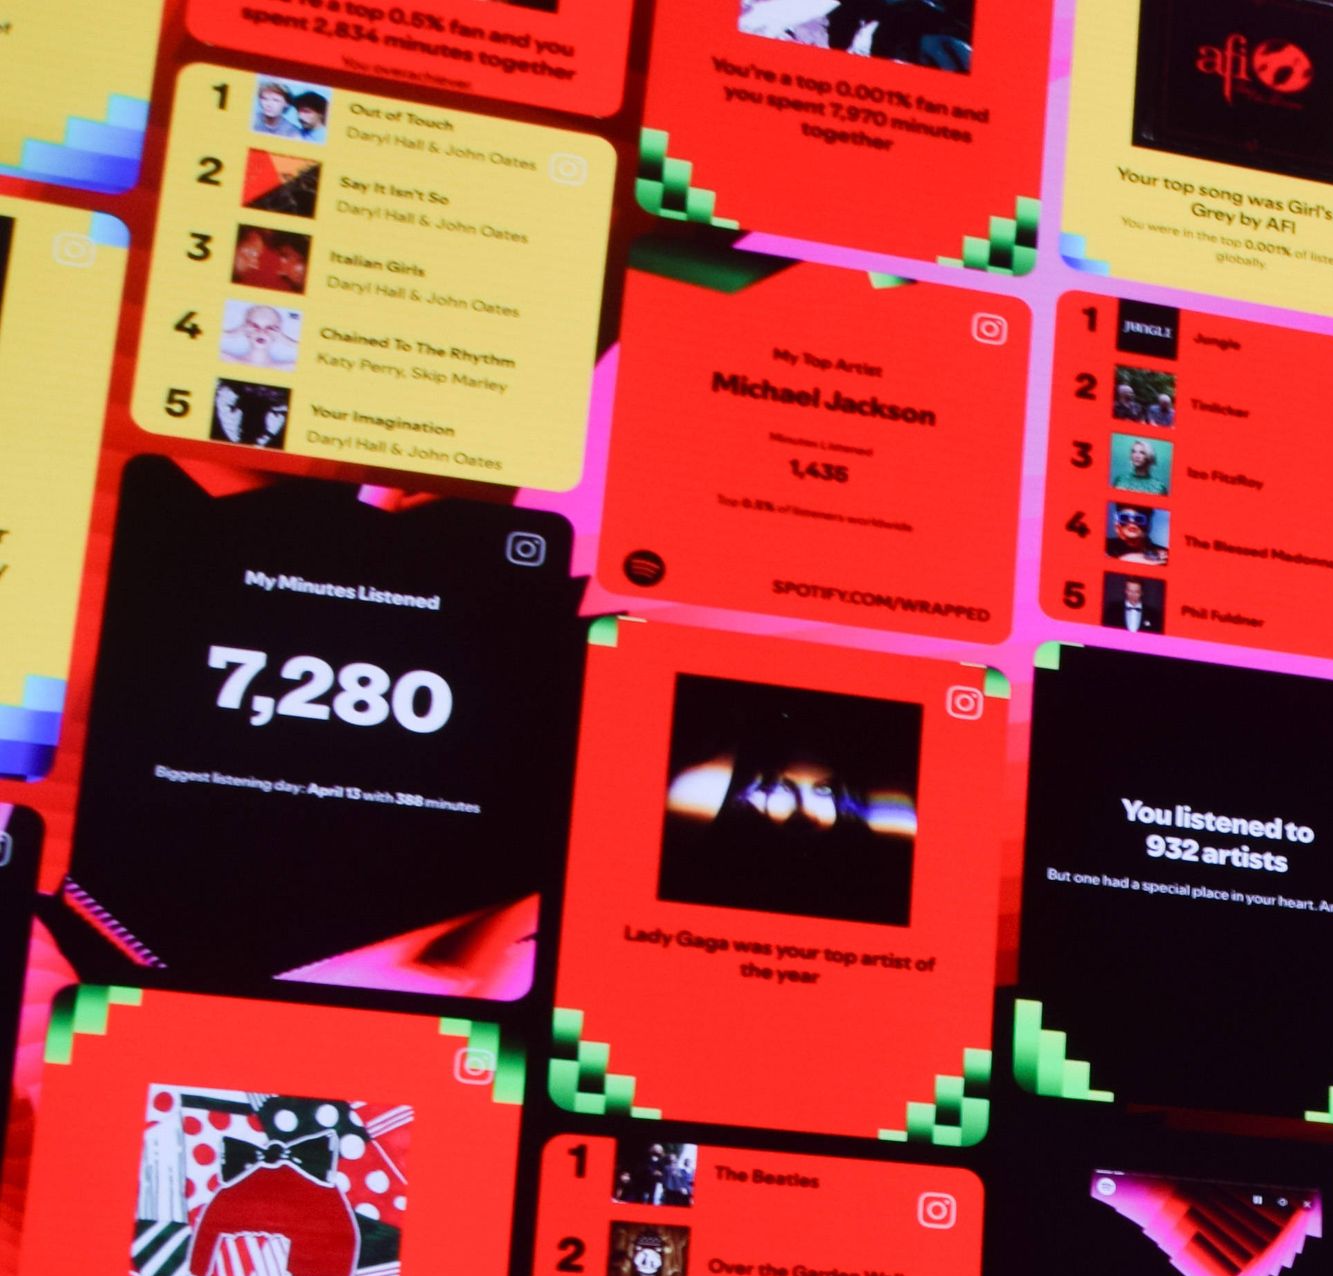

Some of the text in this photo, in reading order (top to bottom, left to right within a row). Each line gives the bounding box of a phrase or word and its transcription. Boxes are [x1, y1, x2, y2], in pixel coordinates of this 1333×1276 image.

[212, 82, 229, 110] 1
[348, 102, 454, 131] Out of Touch
[196, 156, 224, 187] 2
[339, 175, 450, 206] Say It Isn't So
[1116, 165, 1159, 187] Your
[1162, 177, 1195, 196] top
[1198, 185, 1244, 207] song
[1246, 195, 1284, 212] was
[1287, 199, 1333, 221] Girl's
[1190, 201, 1296, 234] Grey by AFI
[186, 231, 213, 262] 3
[329, 250, 426, 278] Italian Girls
[173, 310, 203, 340] 4
[319, 326, 516, 368] Chained To The Rhythm
[164, 387, 191, 419] 5
[711, 370, 936, 426] Michael Jackson
[310, 403, 455, 436] Your Imagination
[789, 458, 849, 484] 1,435
[244, 569, 441, 611] My Minutes Listened
[772, 579, 991, 623] SPOTIFY.COM/WRAPPED
[207, 644, 453, 734] 7,280
[306, 782, 363, 800] April 13
[1121, 797, 1315, 844] You listened to
[1145, 833, 1289, 873] 932 artists
[1046, 866, 1071, 882] But
[1072, 873, 1101, 886] one
[1101, 874, 1130, 889] had
[1130, 879, 1141, 890] a
[1141, 881, 1191, 896] special
[1190, 885, 1230, 901] place
[1229, 889, 1245, 902] in
[1244, 893, 1277, 906] your
[1276, 894, 1317, 911] heart.
[714, 1164, 820, 1189] The Beatles
[707, 1257, 755, 1276] Over
